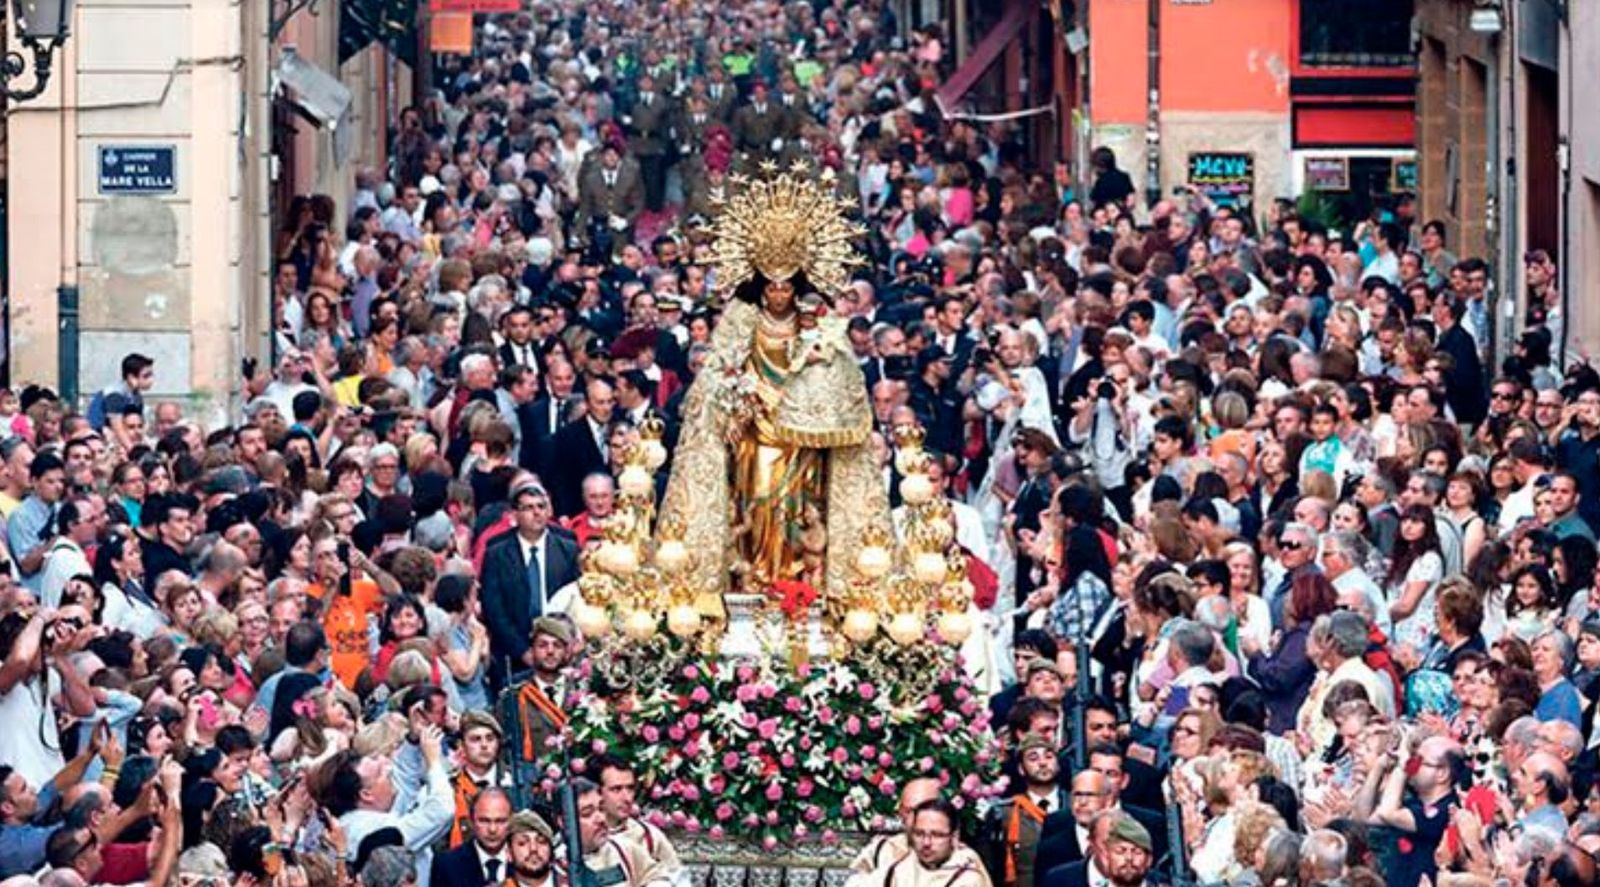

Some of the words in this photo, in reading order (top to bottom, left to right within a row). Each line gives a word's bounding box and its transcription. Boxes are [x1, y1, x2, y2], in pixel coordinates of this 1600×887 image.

[124, 164, 136, 173] DE
[137, 164, 149, 173] LA
[101, 176, 133, 186] MARE
[136, 176, 172, 186] VELLA
